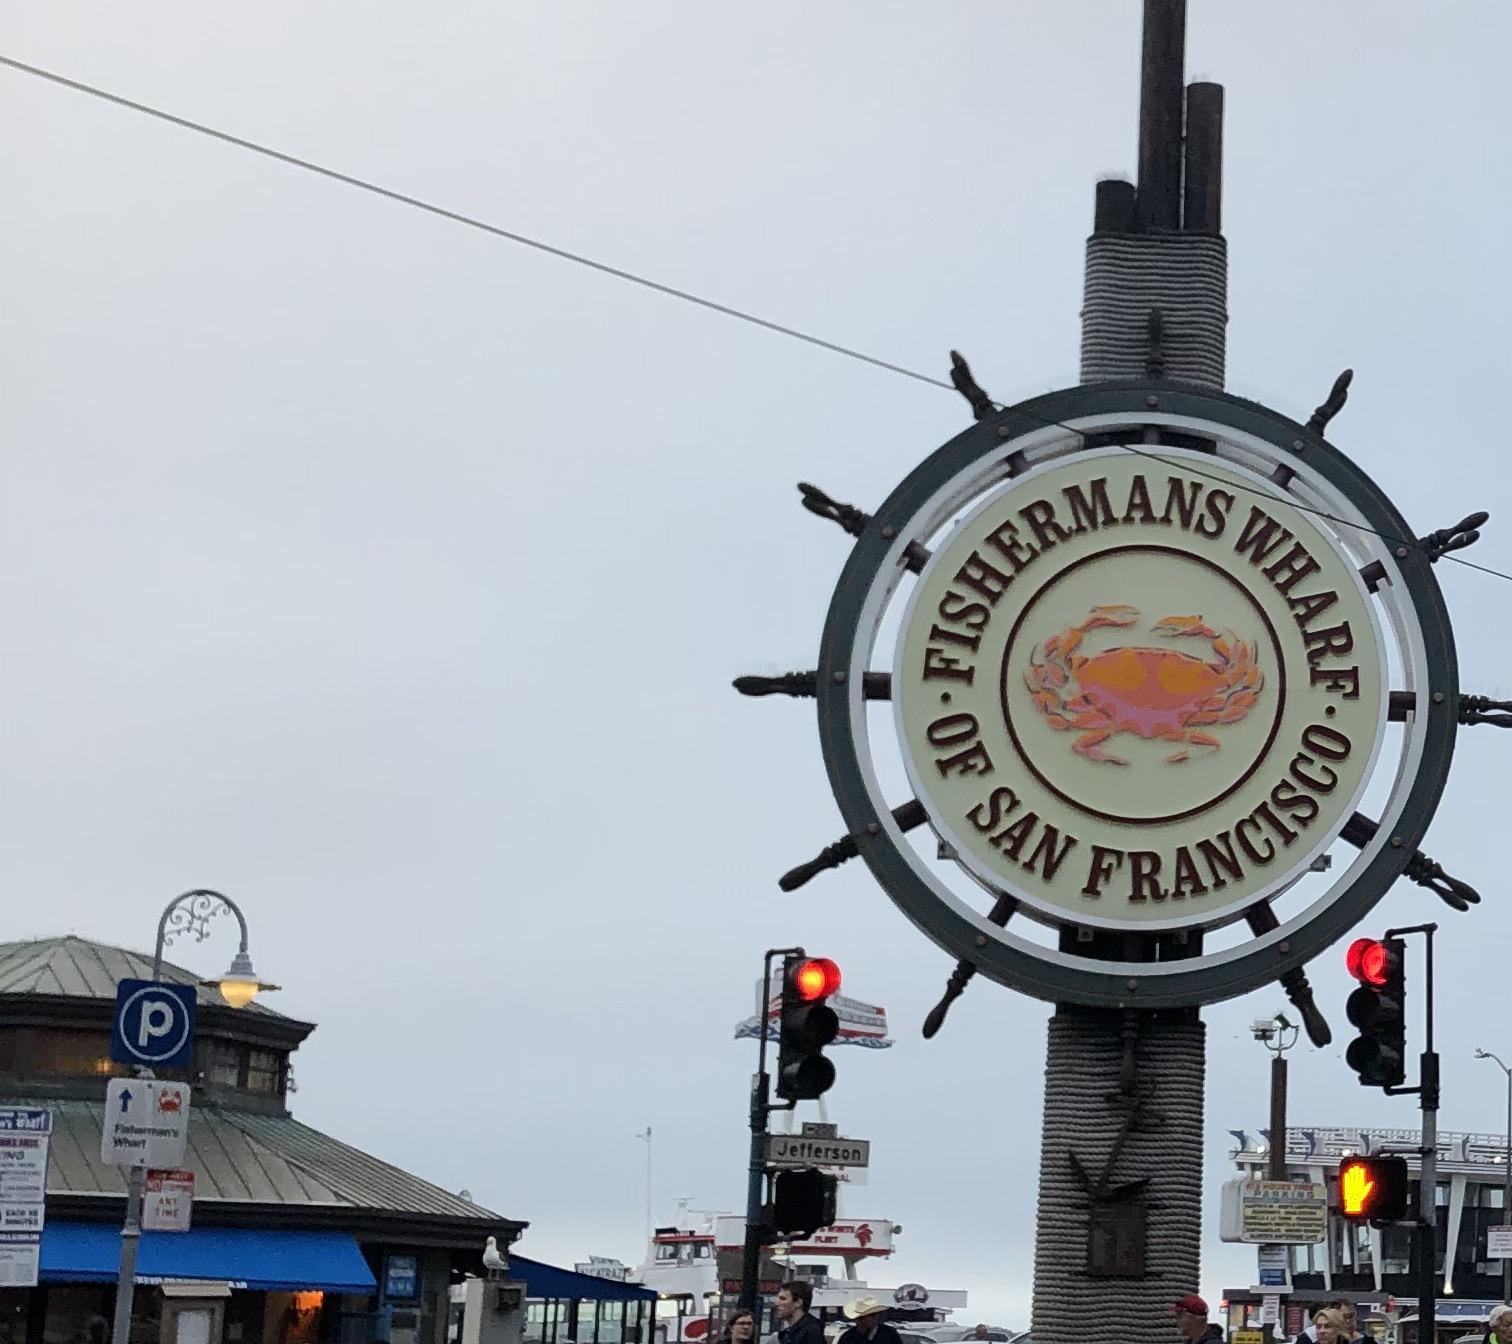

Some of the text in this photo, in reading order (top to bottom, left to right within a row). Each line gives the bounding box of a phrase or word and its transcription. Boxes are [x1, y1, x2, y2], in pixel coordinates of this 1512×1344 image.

[922, 475, 1360, 702] FISHERMANS WHARF
[925, 712, 1354, 904] OF SAN FRANCISCO
[115, 1124, 179, 1139] Fisherman's
[113, 1136, 147, 1150] Wharf
[776, 1141, 862, 1161] Jefferson
